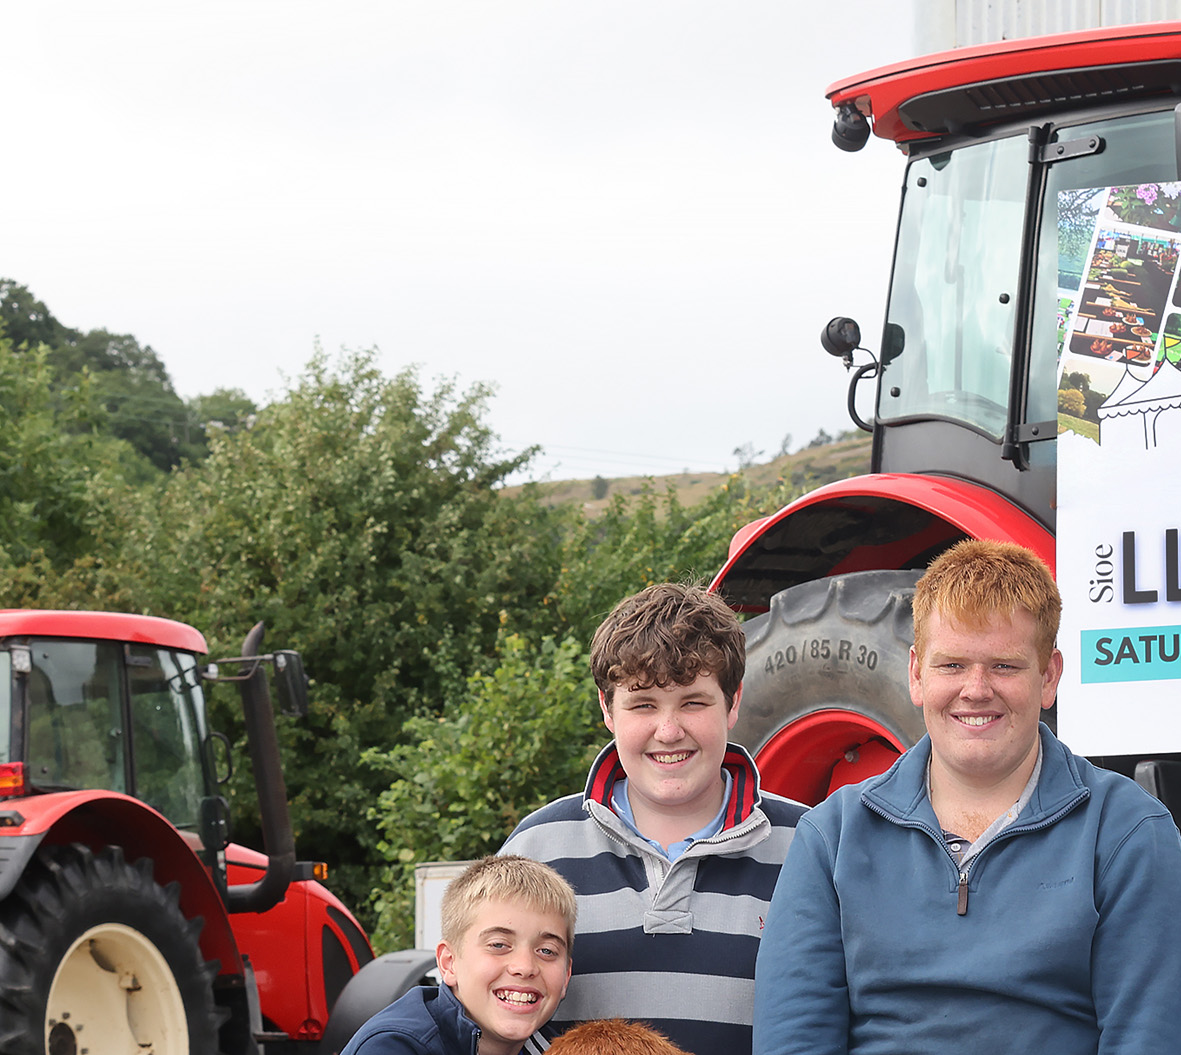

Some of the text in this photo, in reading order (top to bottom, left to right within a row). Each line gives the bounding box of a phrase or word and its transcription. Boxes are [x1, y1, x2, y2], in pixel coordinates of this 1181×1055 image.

[1089, 543, 1114, 603] Sioe
[838, 640, 853, 661] R
[857, 644, 878, 671] 30
